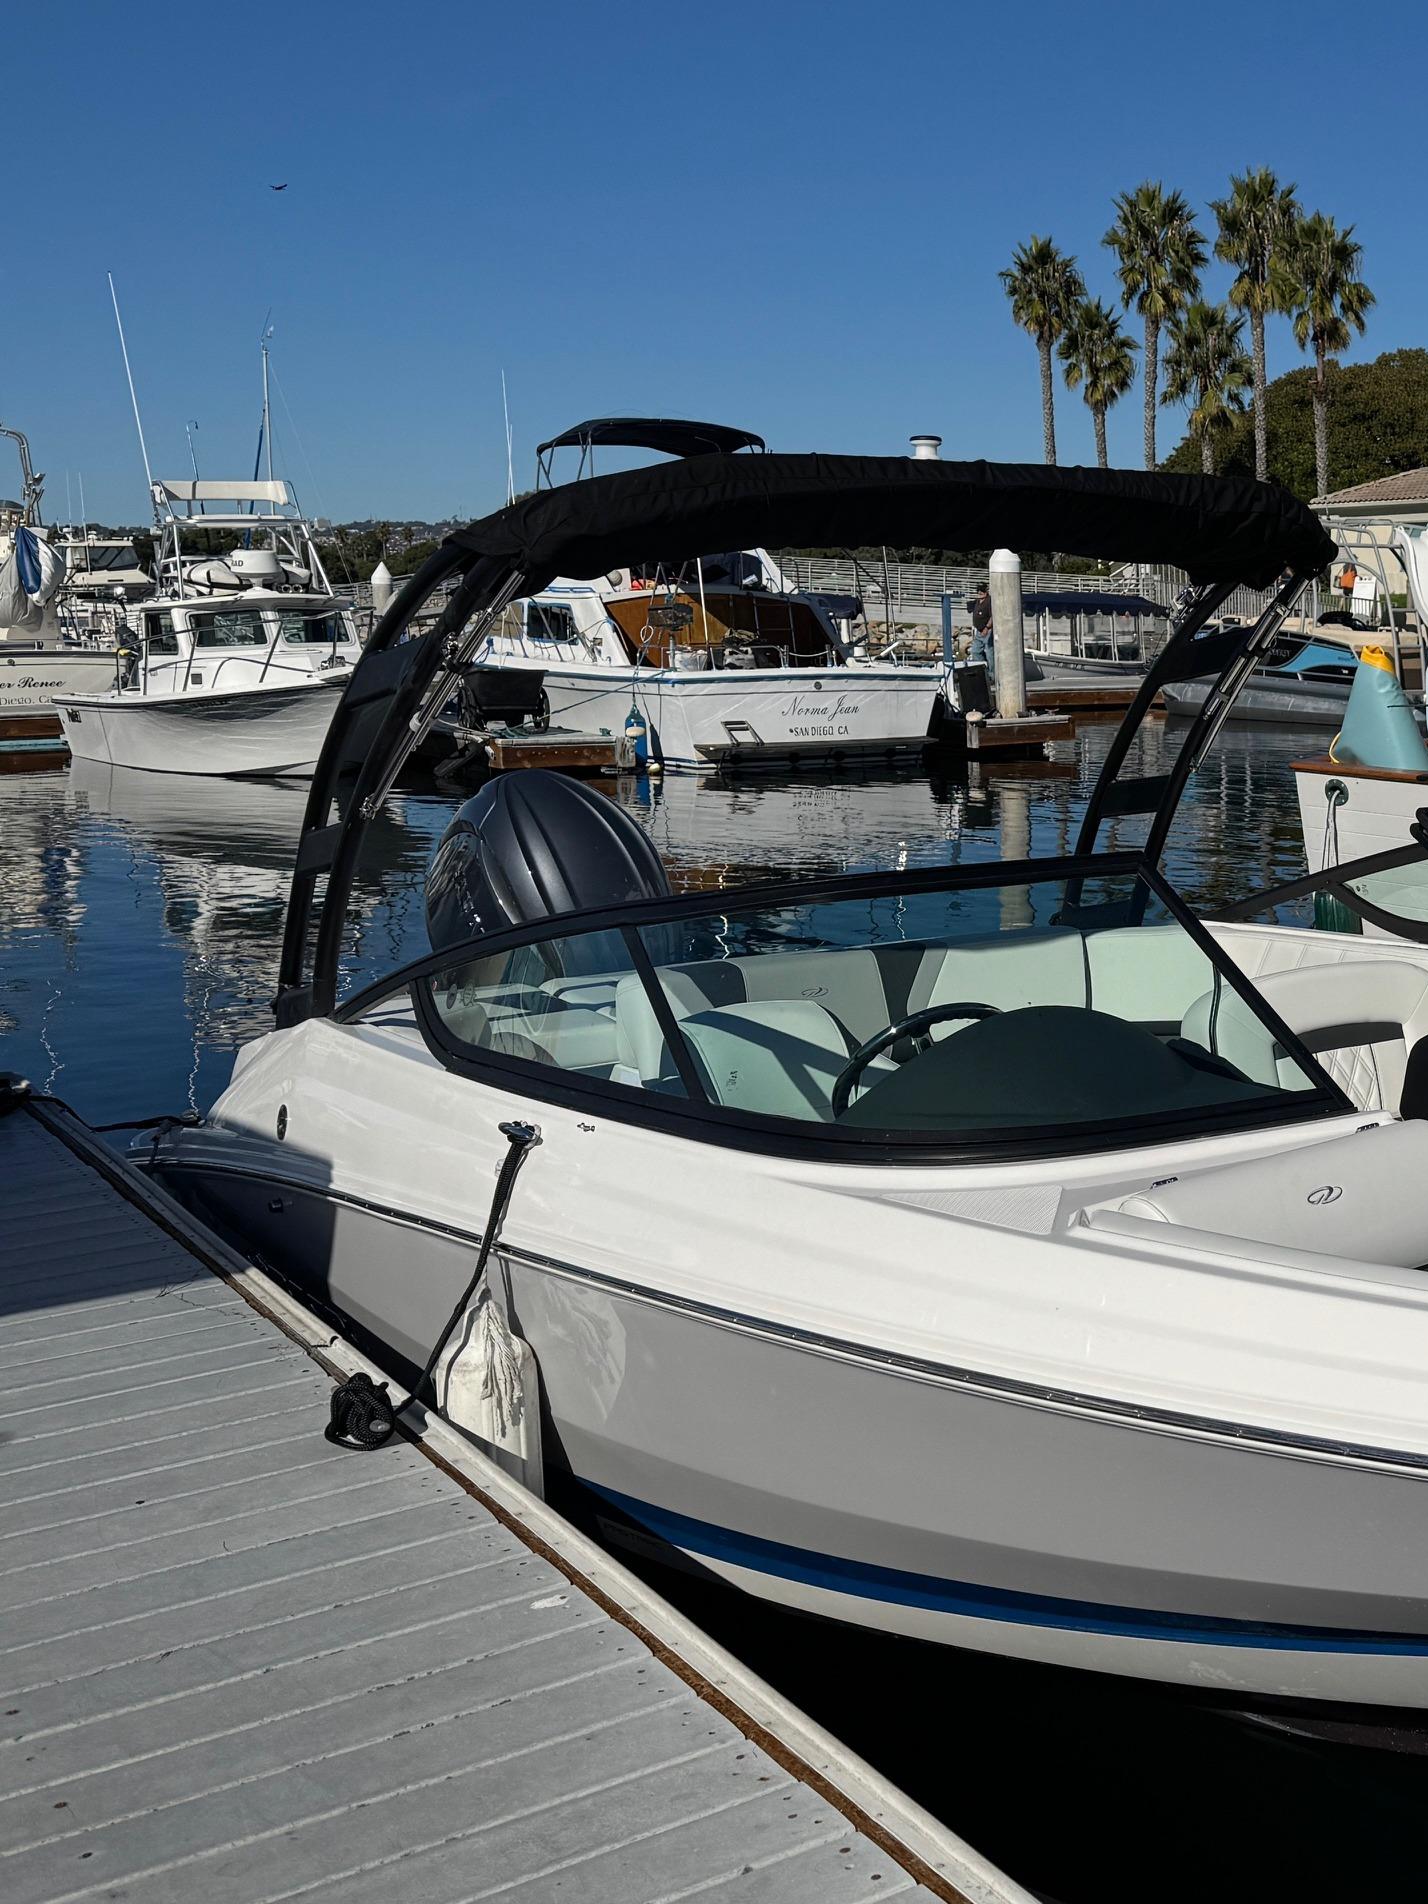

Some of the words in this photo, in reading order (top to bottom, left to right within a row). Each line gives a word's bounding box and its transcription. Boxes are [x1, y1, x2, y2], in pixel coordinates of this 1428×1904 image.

[18, 676, 66, 689] Renee
[781, 695, 829, 717] Norma
[827, 693, 860, 722] Jean
[837, 725, 849, 735] CA
